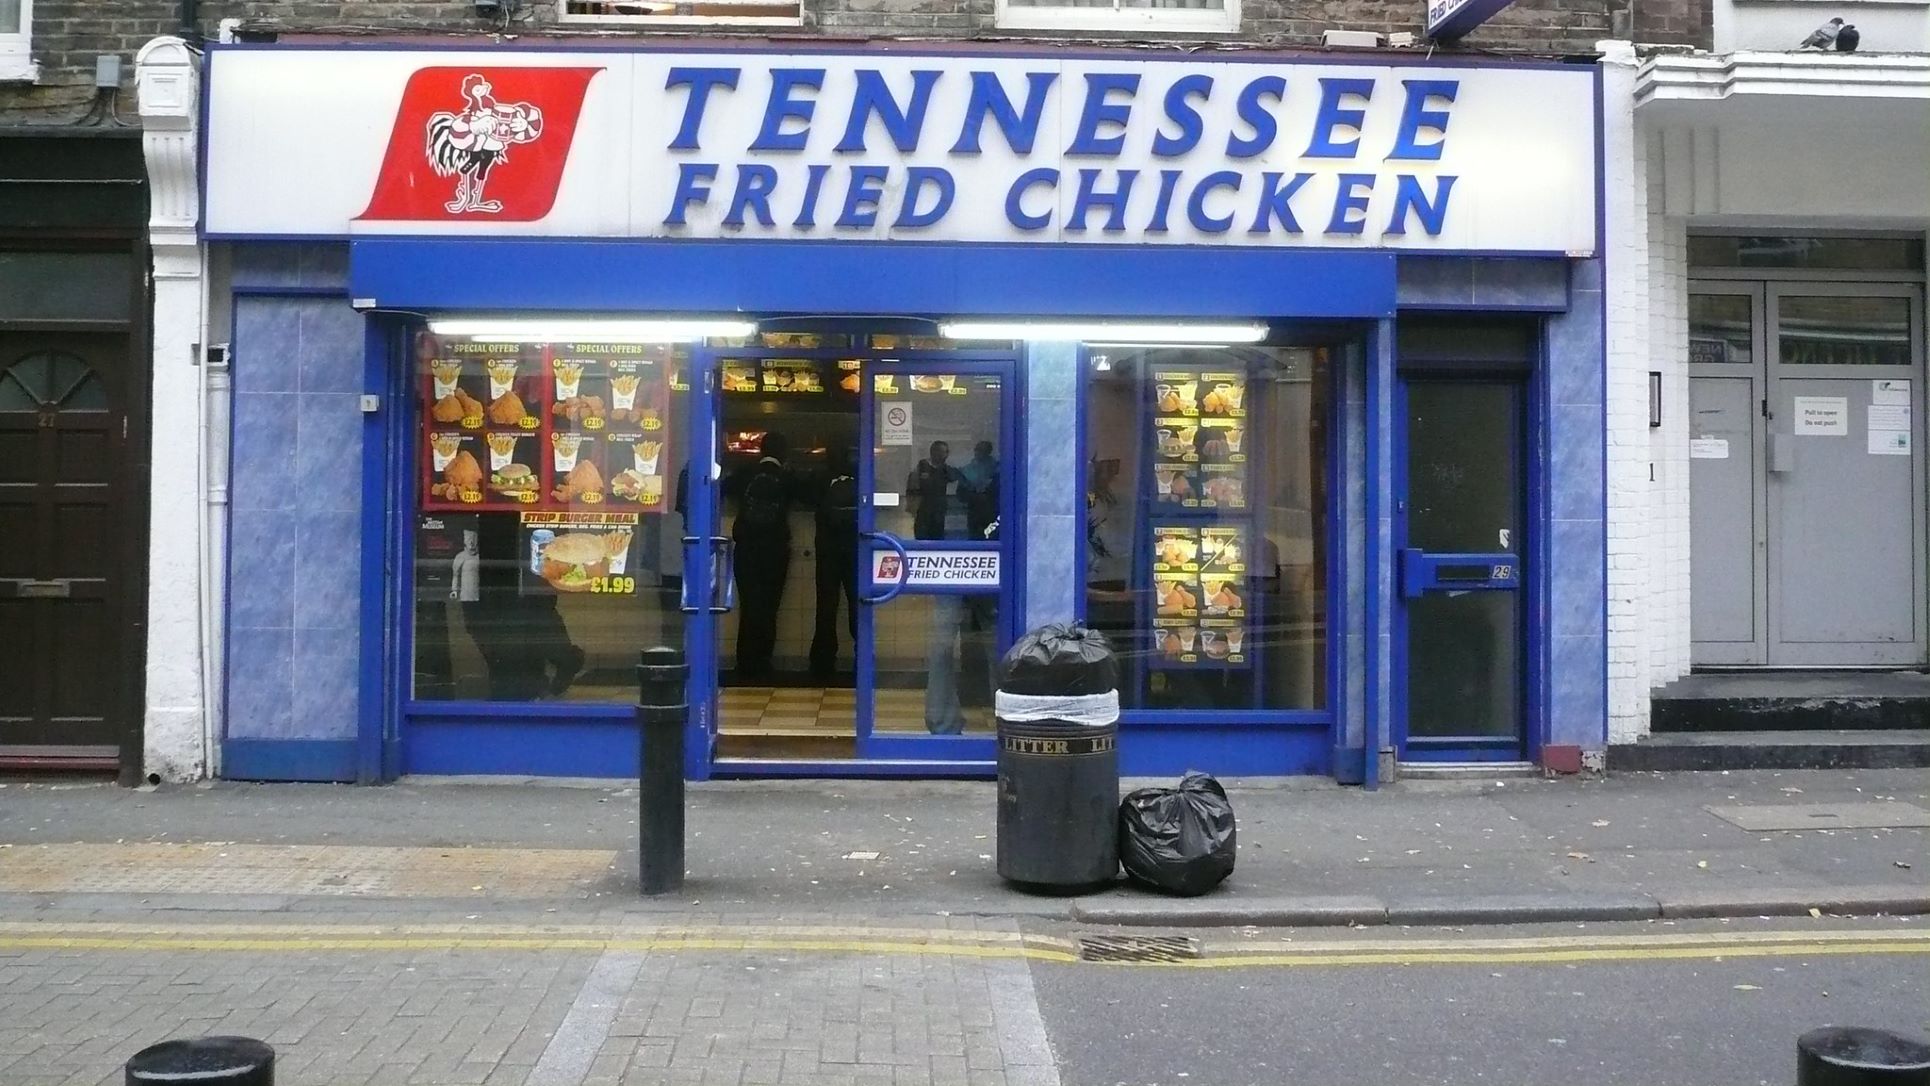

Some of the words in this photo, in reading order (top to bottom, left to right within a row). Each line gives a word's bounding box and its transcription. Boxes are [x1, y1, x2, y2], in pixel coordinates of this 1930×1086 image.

[665, 67, 1460, 161] TENNESSEE
[663, 163, 956, 229] FRIED
[1005, 167, 1459, 236] CHICKEN
[454, 344, 487, 353] SPECIAL
[488, 344, 520, 353] OFFERS
[576, 344, 609, 353] SPECIAL
[610, 345, 642, 354] OFFERS
[523, 512, 557, 522] STRIP
[559, 513, 603, 523] BURGER
[605, 513, 636, 523] MEAL
[908, 556, 997, 569] TENNESSEE
[909, 569, 941, 579] FRIED
[943, 570, 997, 579] CHICKEN
[1493, 566, 1510, 578] 29
[590, 576, 635, 593] £1.99
[1005, 737, 1070, 754] LITTER
